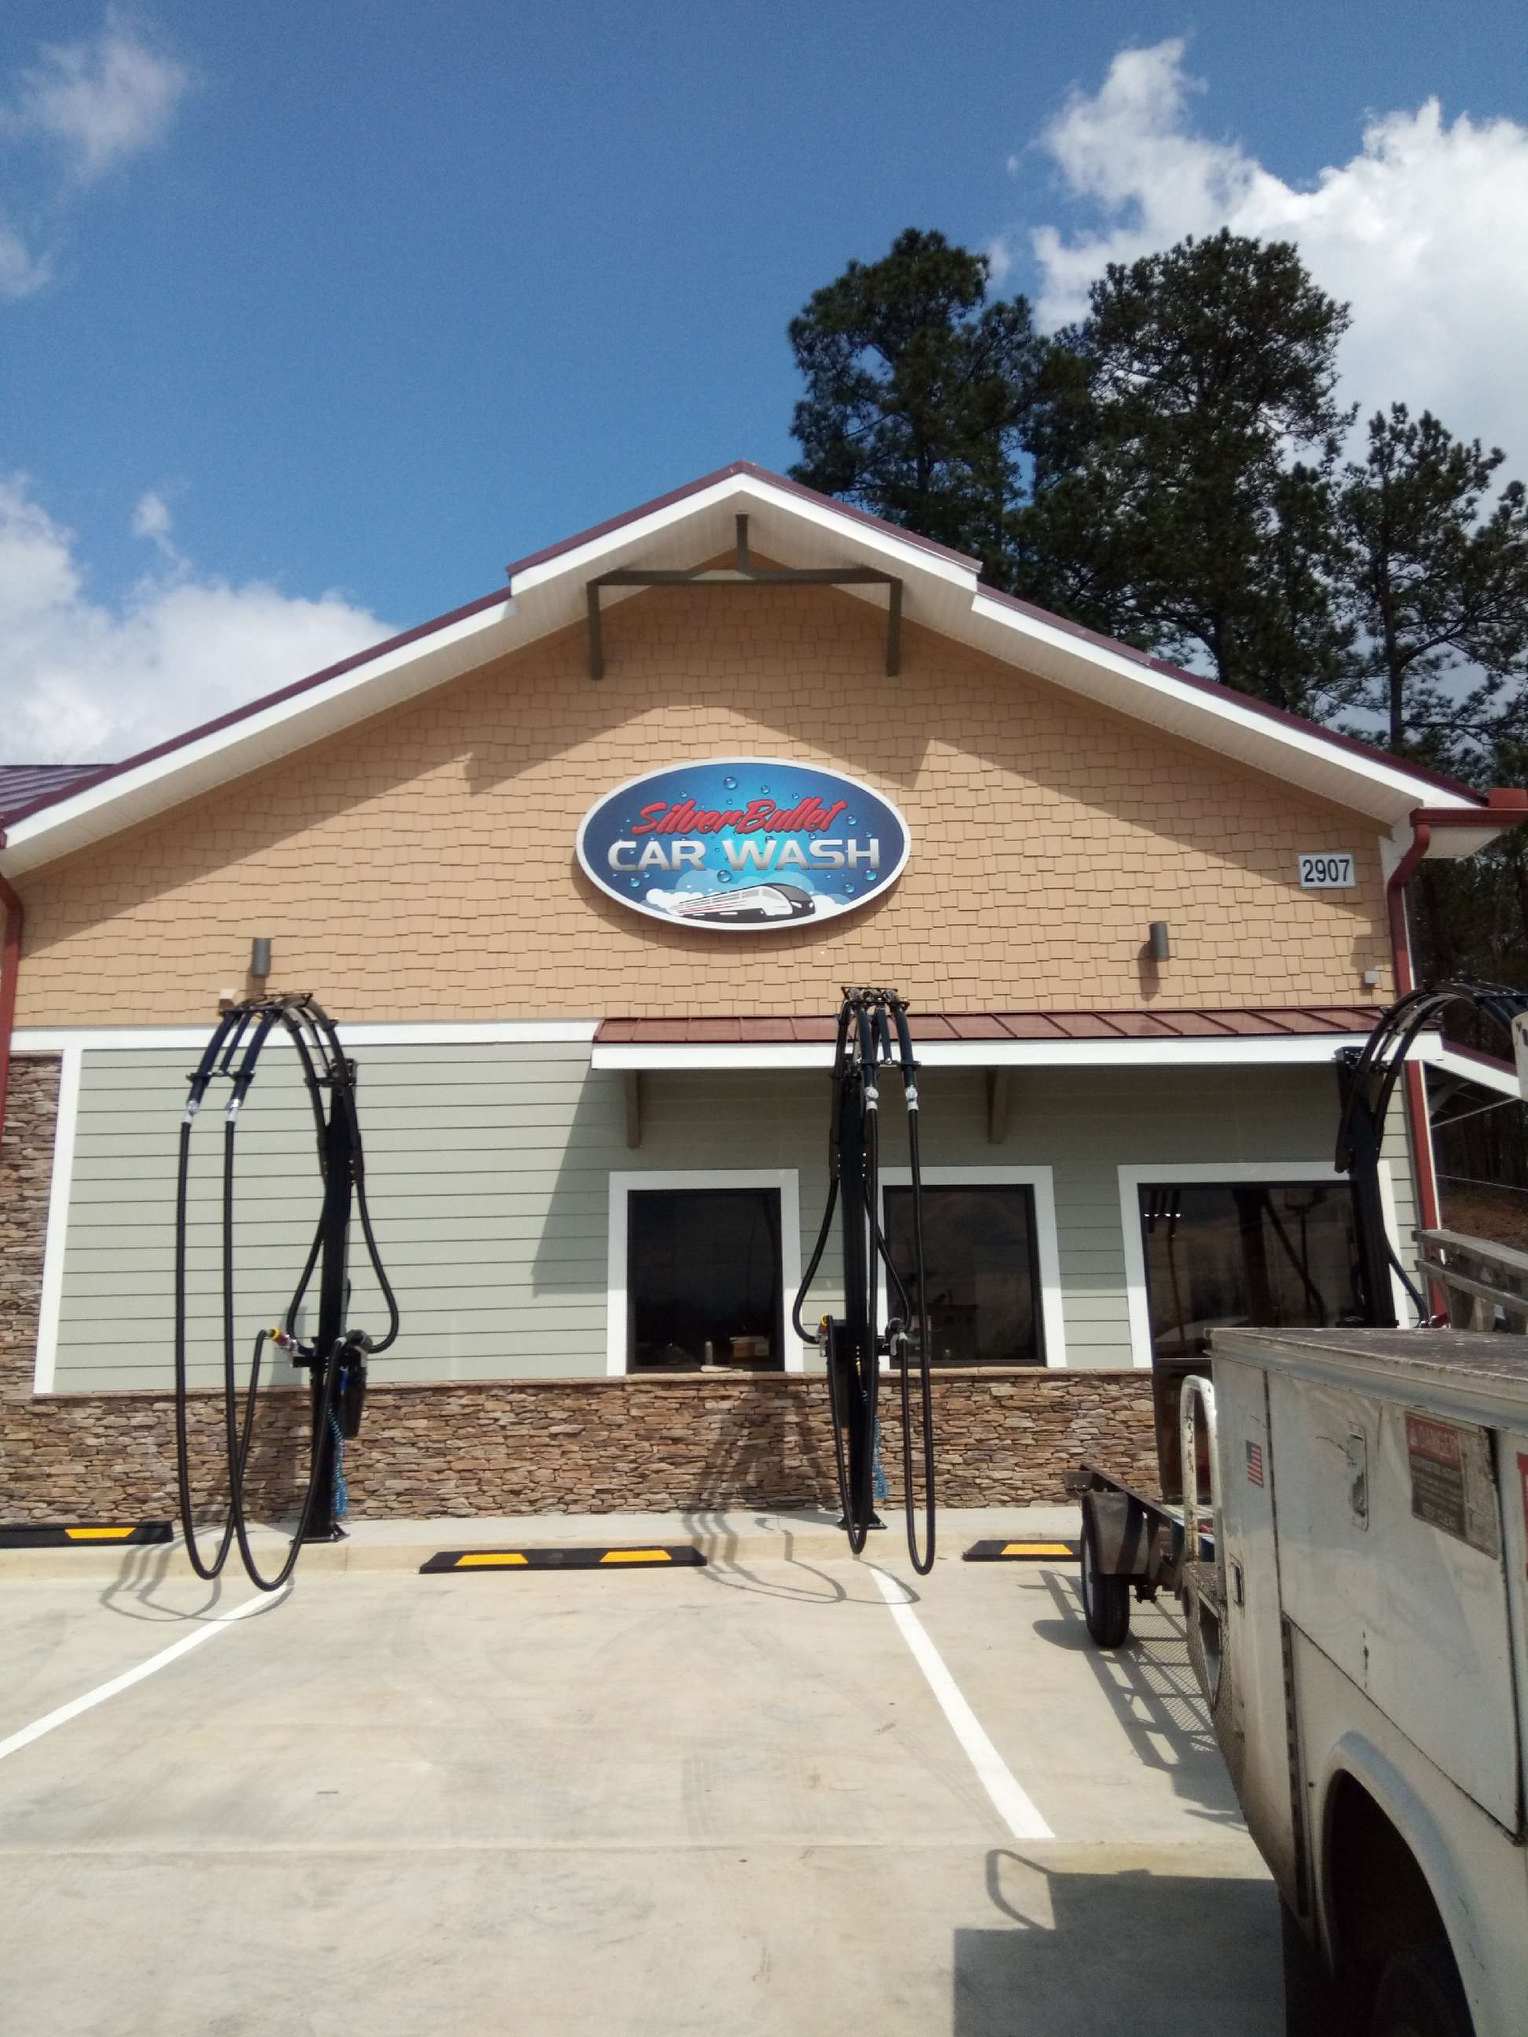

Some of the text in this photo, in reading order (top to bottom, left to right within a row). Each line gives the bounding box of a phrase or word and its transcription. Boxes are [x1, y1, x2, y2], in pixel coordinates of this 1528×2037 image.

[608, 838, 880, 871] CAR WASH
[1303, 859, 1350, 882] 2907
